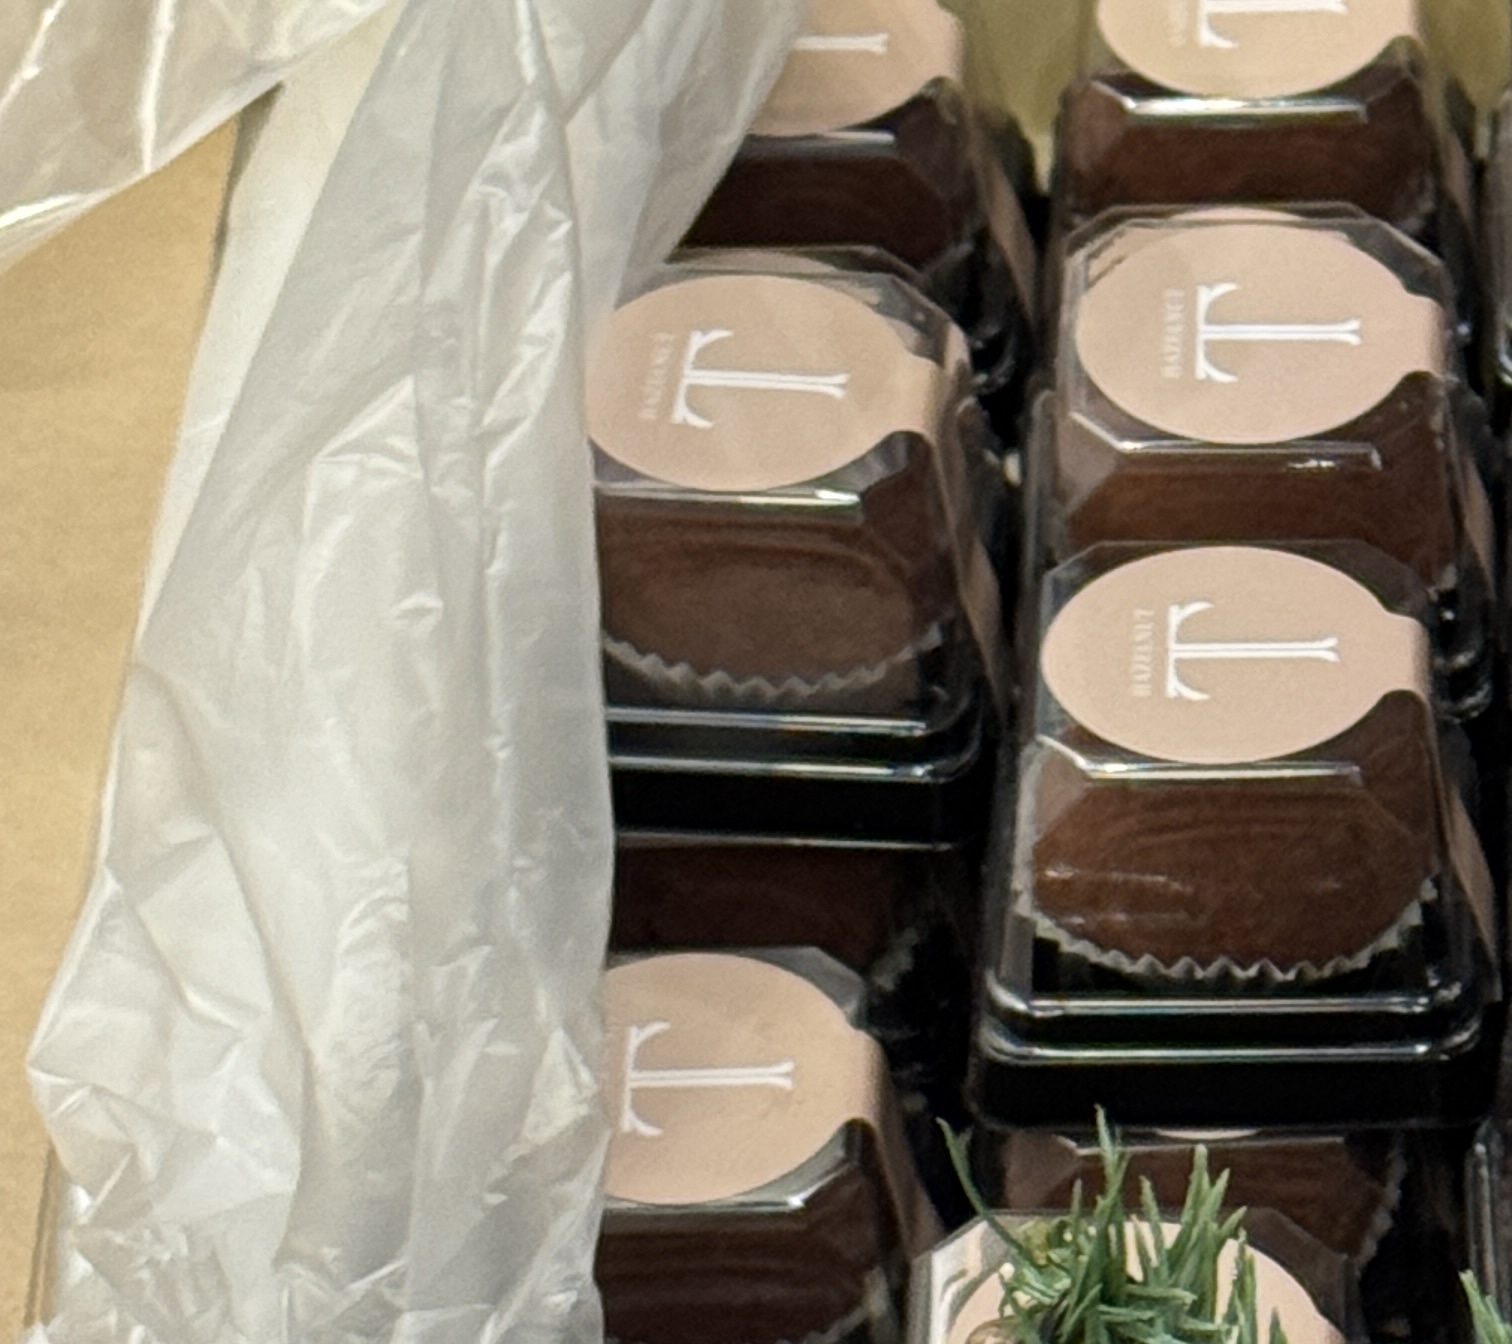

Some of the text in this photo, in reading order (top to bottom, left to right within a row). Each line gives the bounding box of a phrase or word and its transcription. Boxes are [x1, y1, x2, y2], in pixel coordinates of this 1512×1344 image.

[672, 329, 849, 428] T
[1195, 282, 1361, 382] T
[1167, 602, 1339, 701] T
[620, 1021, 794, 1136] T
